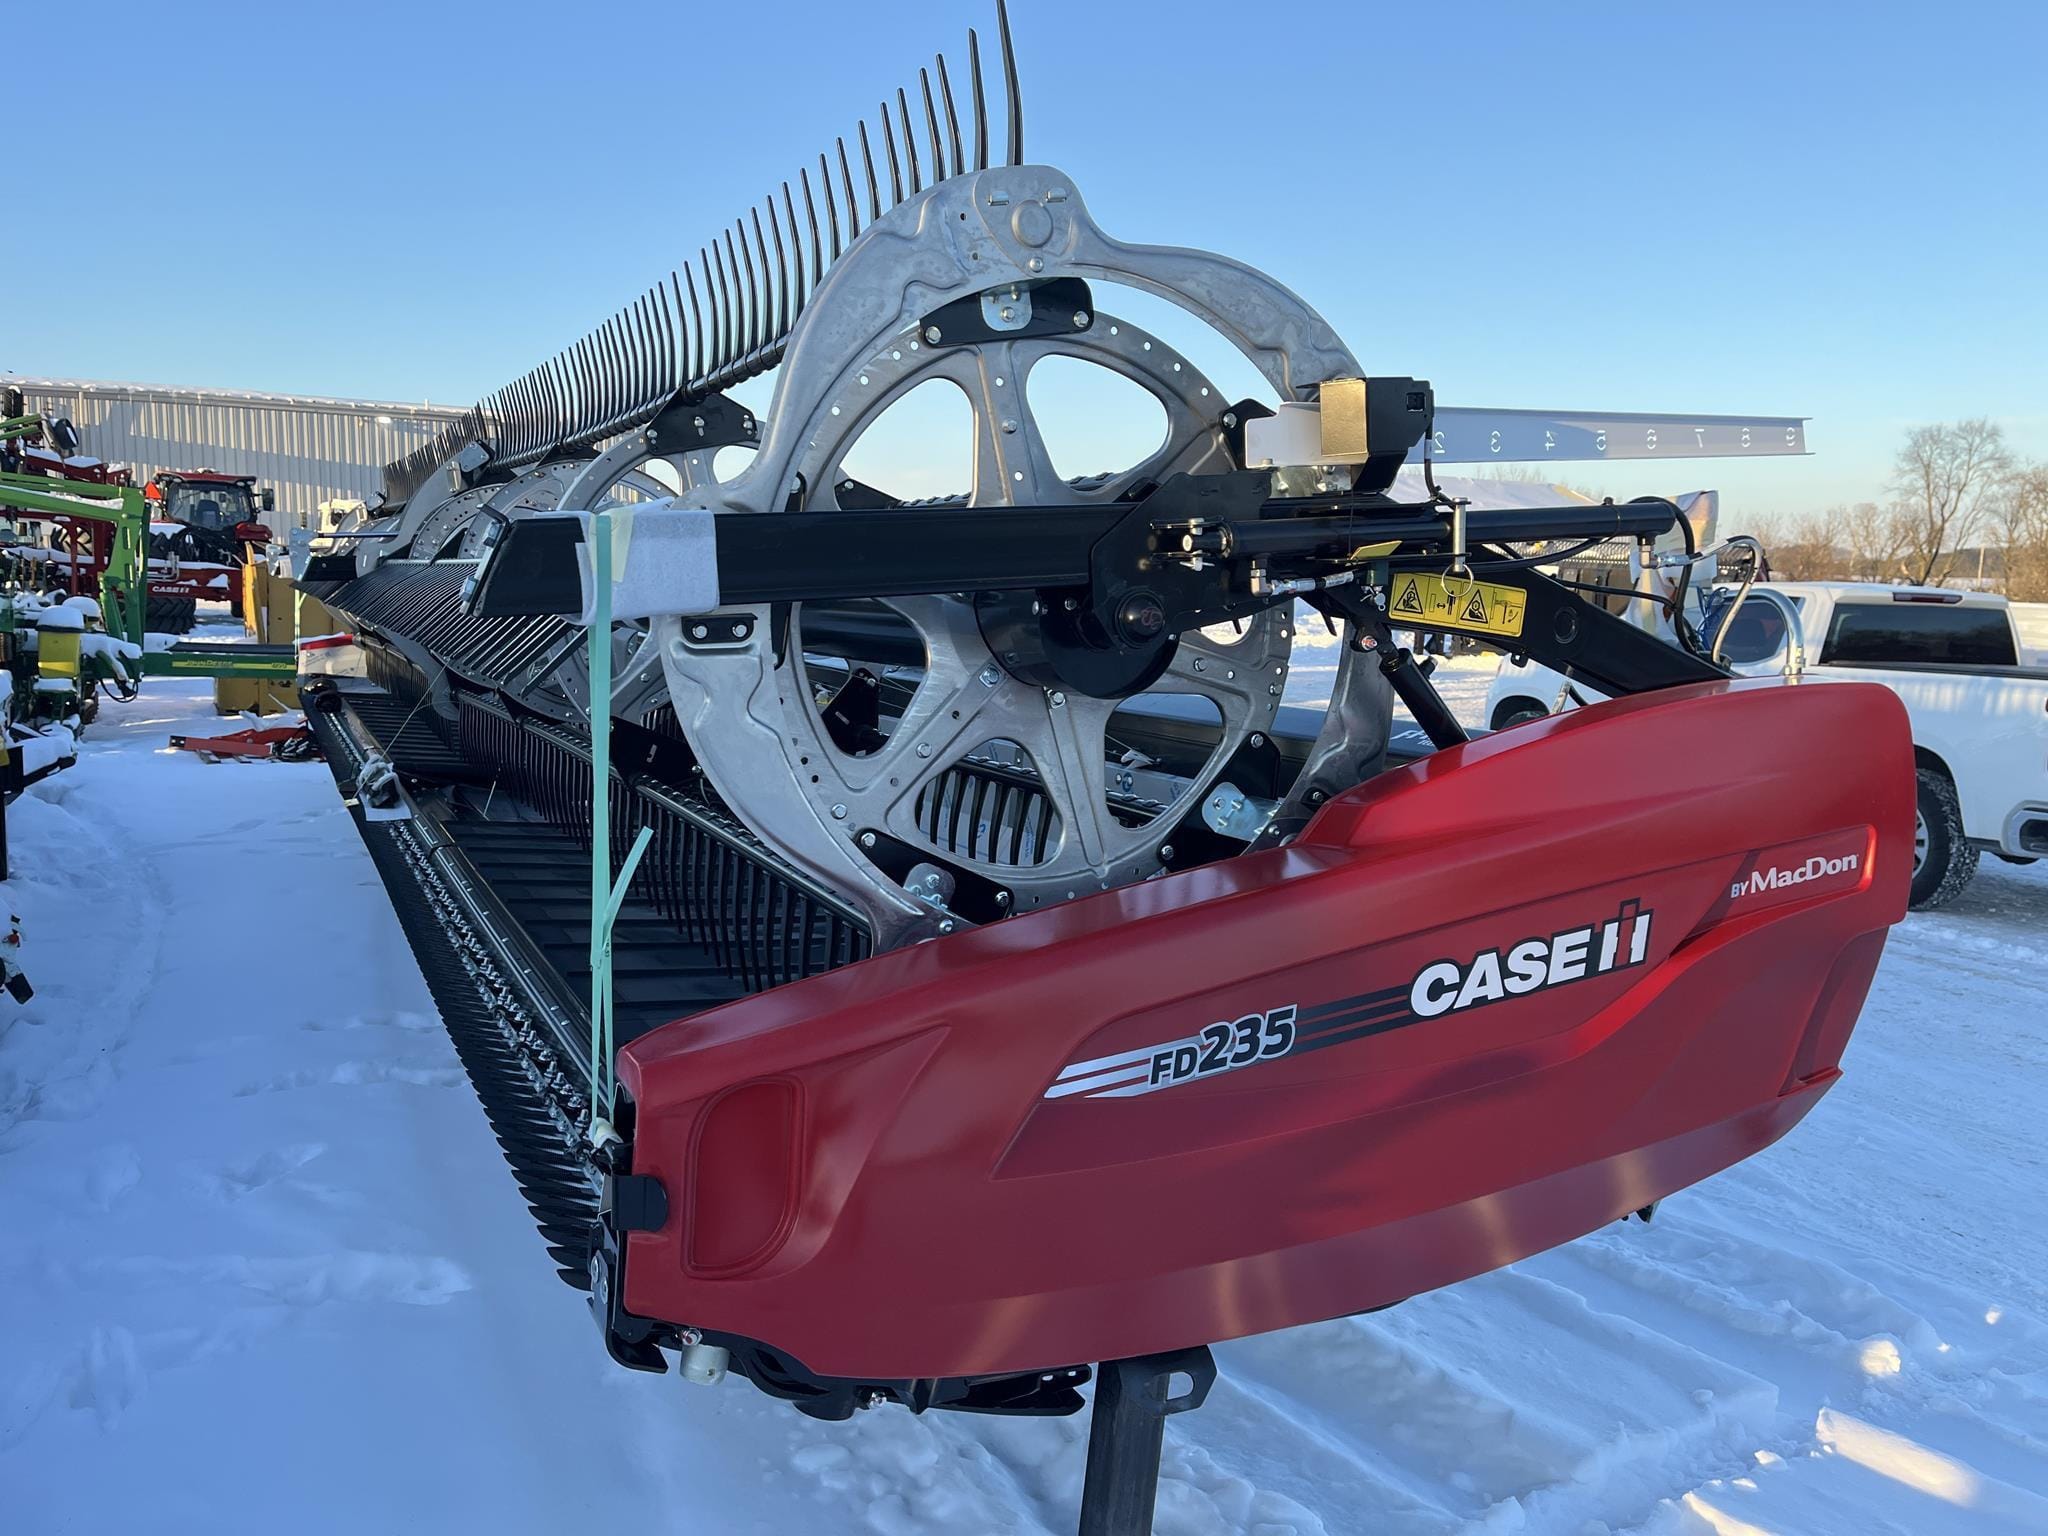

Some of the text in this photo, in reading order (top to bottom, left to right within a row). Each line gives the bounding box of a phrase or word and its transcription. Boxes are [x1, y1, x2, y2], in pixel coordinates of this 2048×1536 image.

[152, 585, 179, 593] CASE
[1730, 853, 1858, 899] BY MacDon
[1410, 927, 1593, 1018] CASE
[1148, 1004, 1298, 1088] FD235
